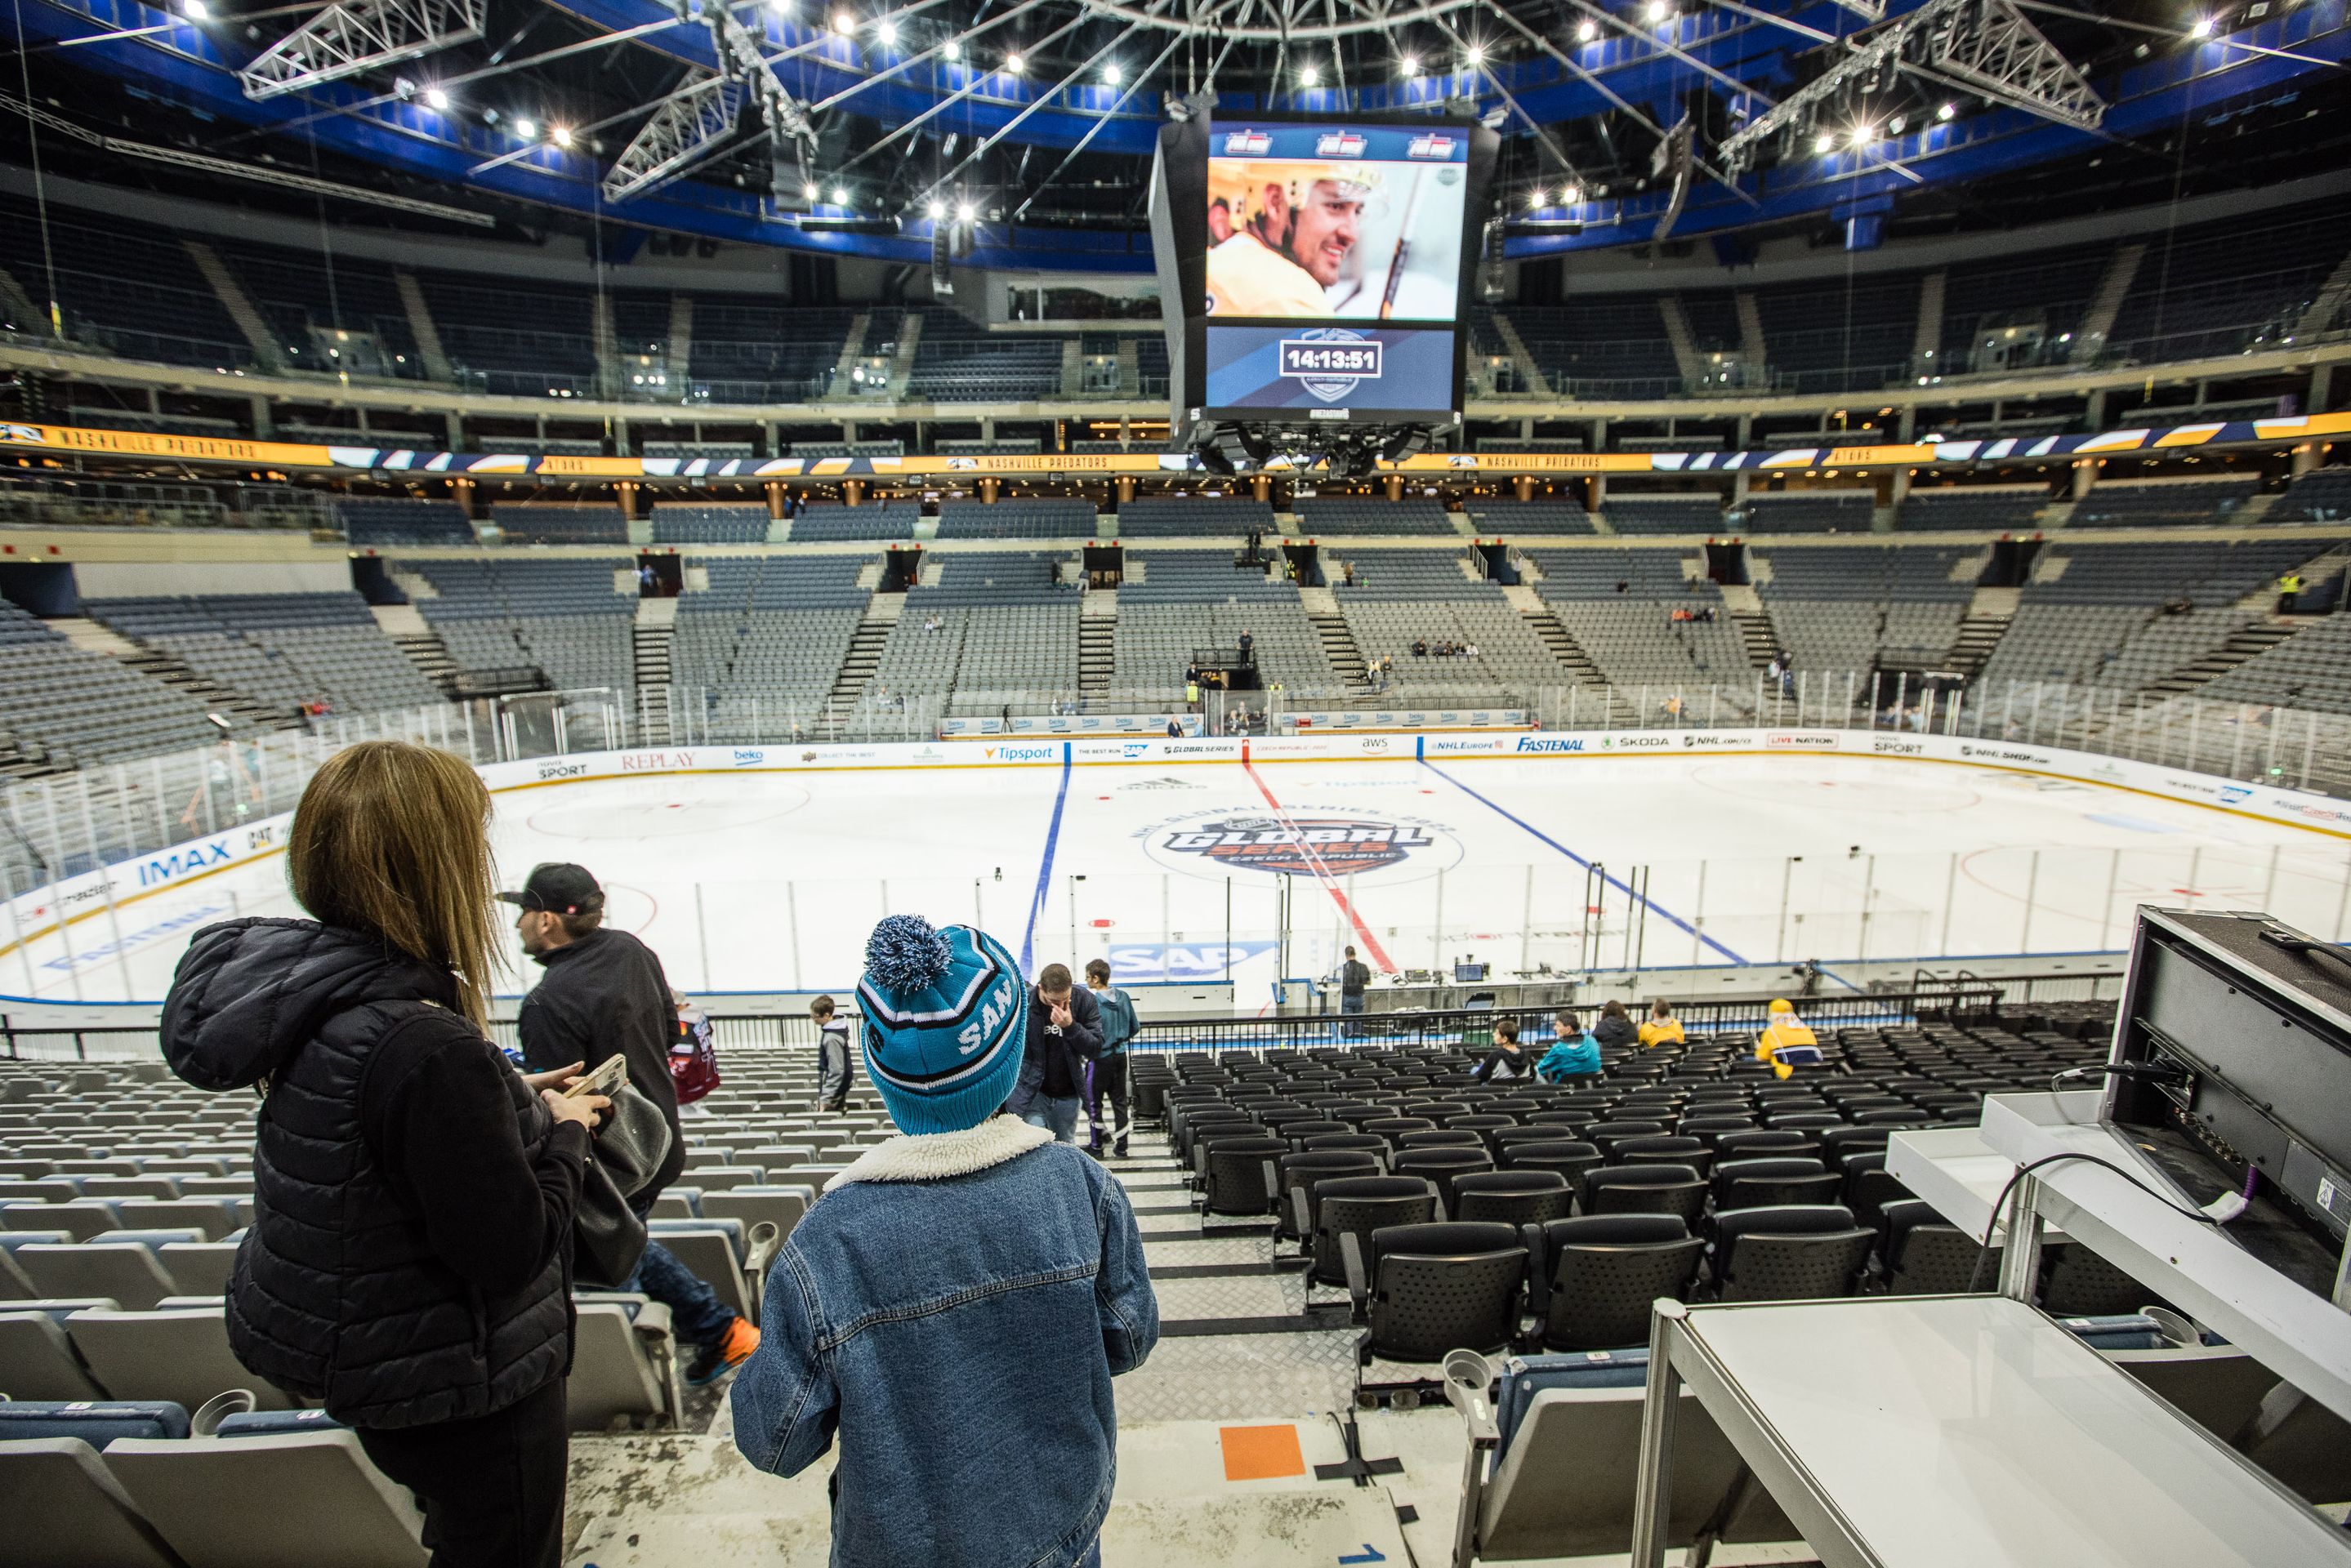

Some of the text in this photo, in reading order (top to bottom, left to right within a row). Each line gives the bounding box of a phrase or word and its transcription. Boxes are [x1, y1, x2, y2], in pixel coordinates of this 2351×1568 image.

[1287, 350, 1375, 370] 14:13:51
[988, 457, 1108, 468] NASHVILLE PREDATORS
[1487, 456, 1600, 466] NASHVILLE PREDATORS
[1362, 737, 1388, 747] aws
[1516, 737, 1586, 751] FASTENAL
[1875, 742, 1925, 754] SPORT
[734, 750, 764, 760] beko
[999, 747, 1052, 760] Tipsport
[1124, 745, 1146, 756] SAP
[622, 752, 696, 770] REPLAY
[538, 764, 588, 780] SPORT
[1167, 827, 1433, 849] GLOBAL
[1207, 842, 1390, 856] SERIES
[137, 840, 232, 886] IMAX
[1109, 947, 1250, 972] SAP
[957, 979, 1013, 1055] SAN
